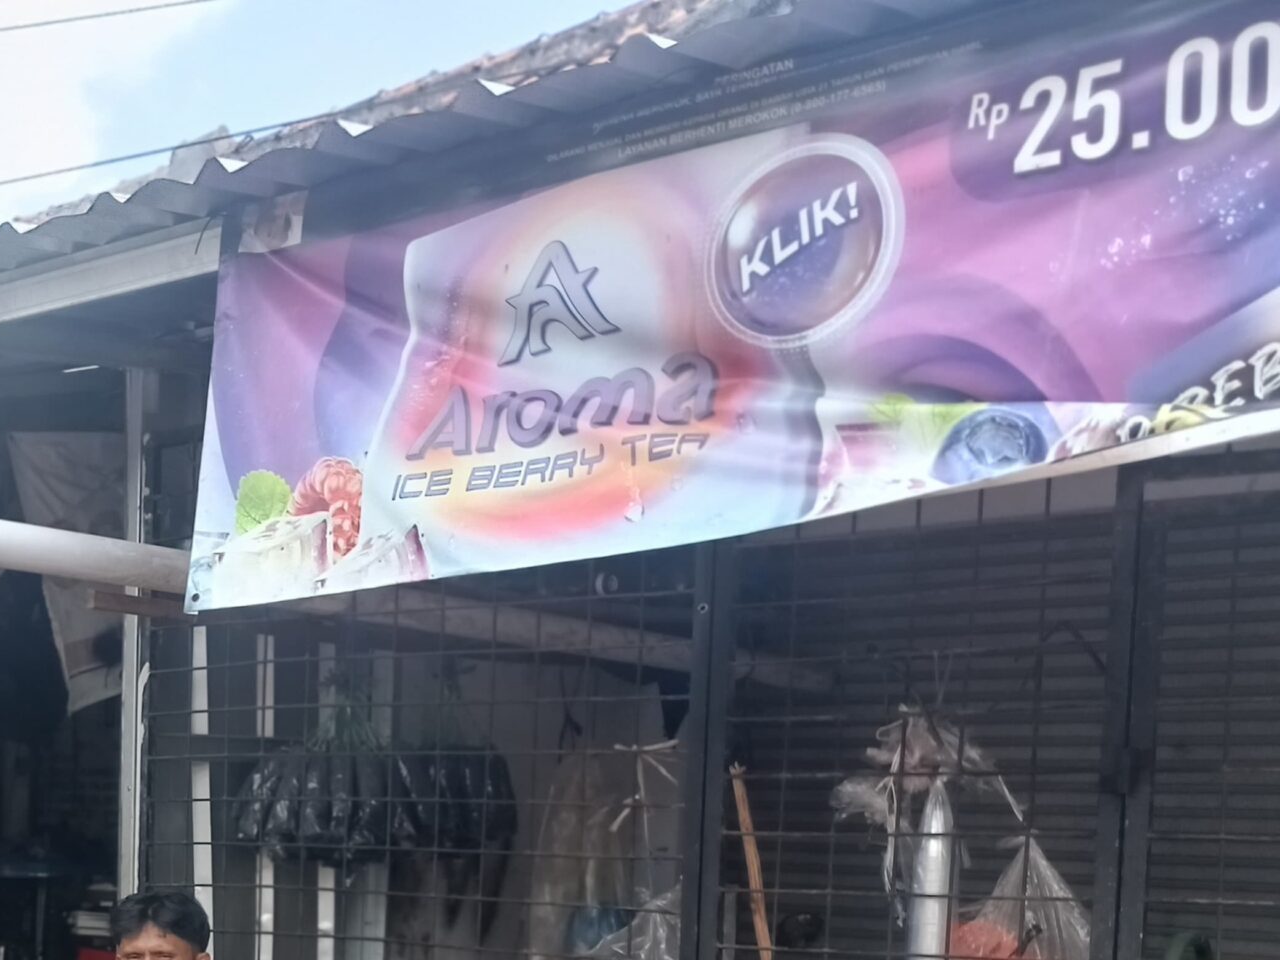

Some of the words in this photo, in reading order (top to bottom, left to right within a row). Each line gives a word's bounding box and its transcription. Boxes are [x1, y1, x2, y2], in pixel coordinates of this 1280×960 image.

[967, 93, 1009, 140] Rp
[738, 182, 860, 292] KLIK!
[406, 352, 718, 461] Aroma
[392, 467, 452, 501] ICE
[465, 444, 605, 493] BERRY
[620, 432, 709, 468] TEA
